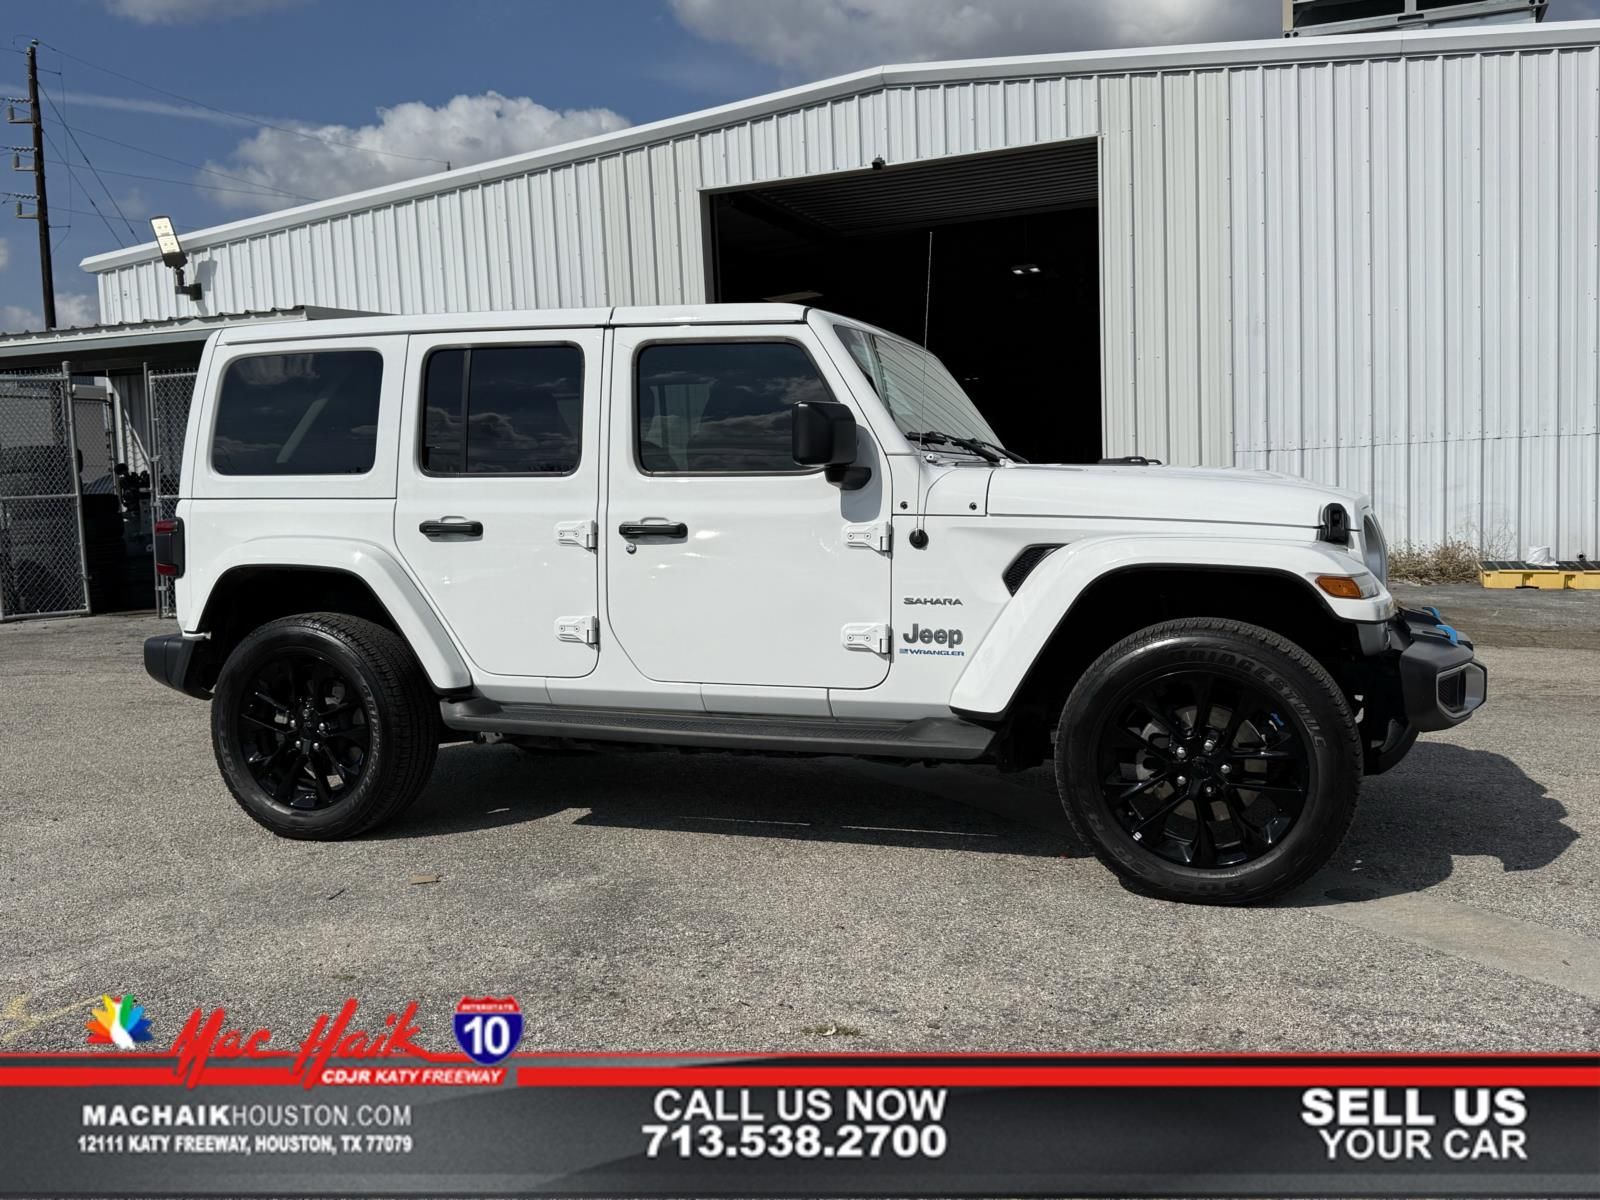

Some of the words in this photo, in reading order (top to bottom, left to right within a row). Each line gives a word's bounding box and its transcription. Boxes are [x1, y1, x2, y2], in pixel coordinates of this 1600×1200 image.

[903, 597, 963, 606] SAHARA
[902, 623, 963, 649] Jeep
[909, 648, 965, 657] WRANGLER
